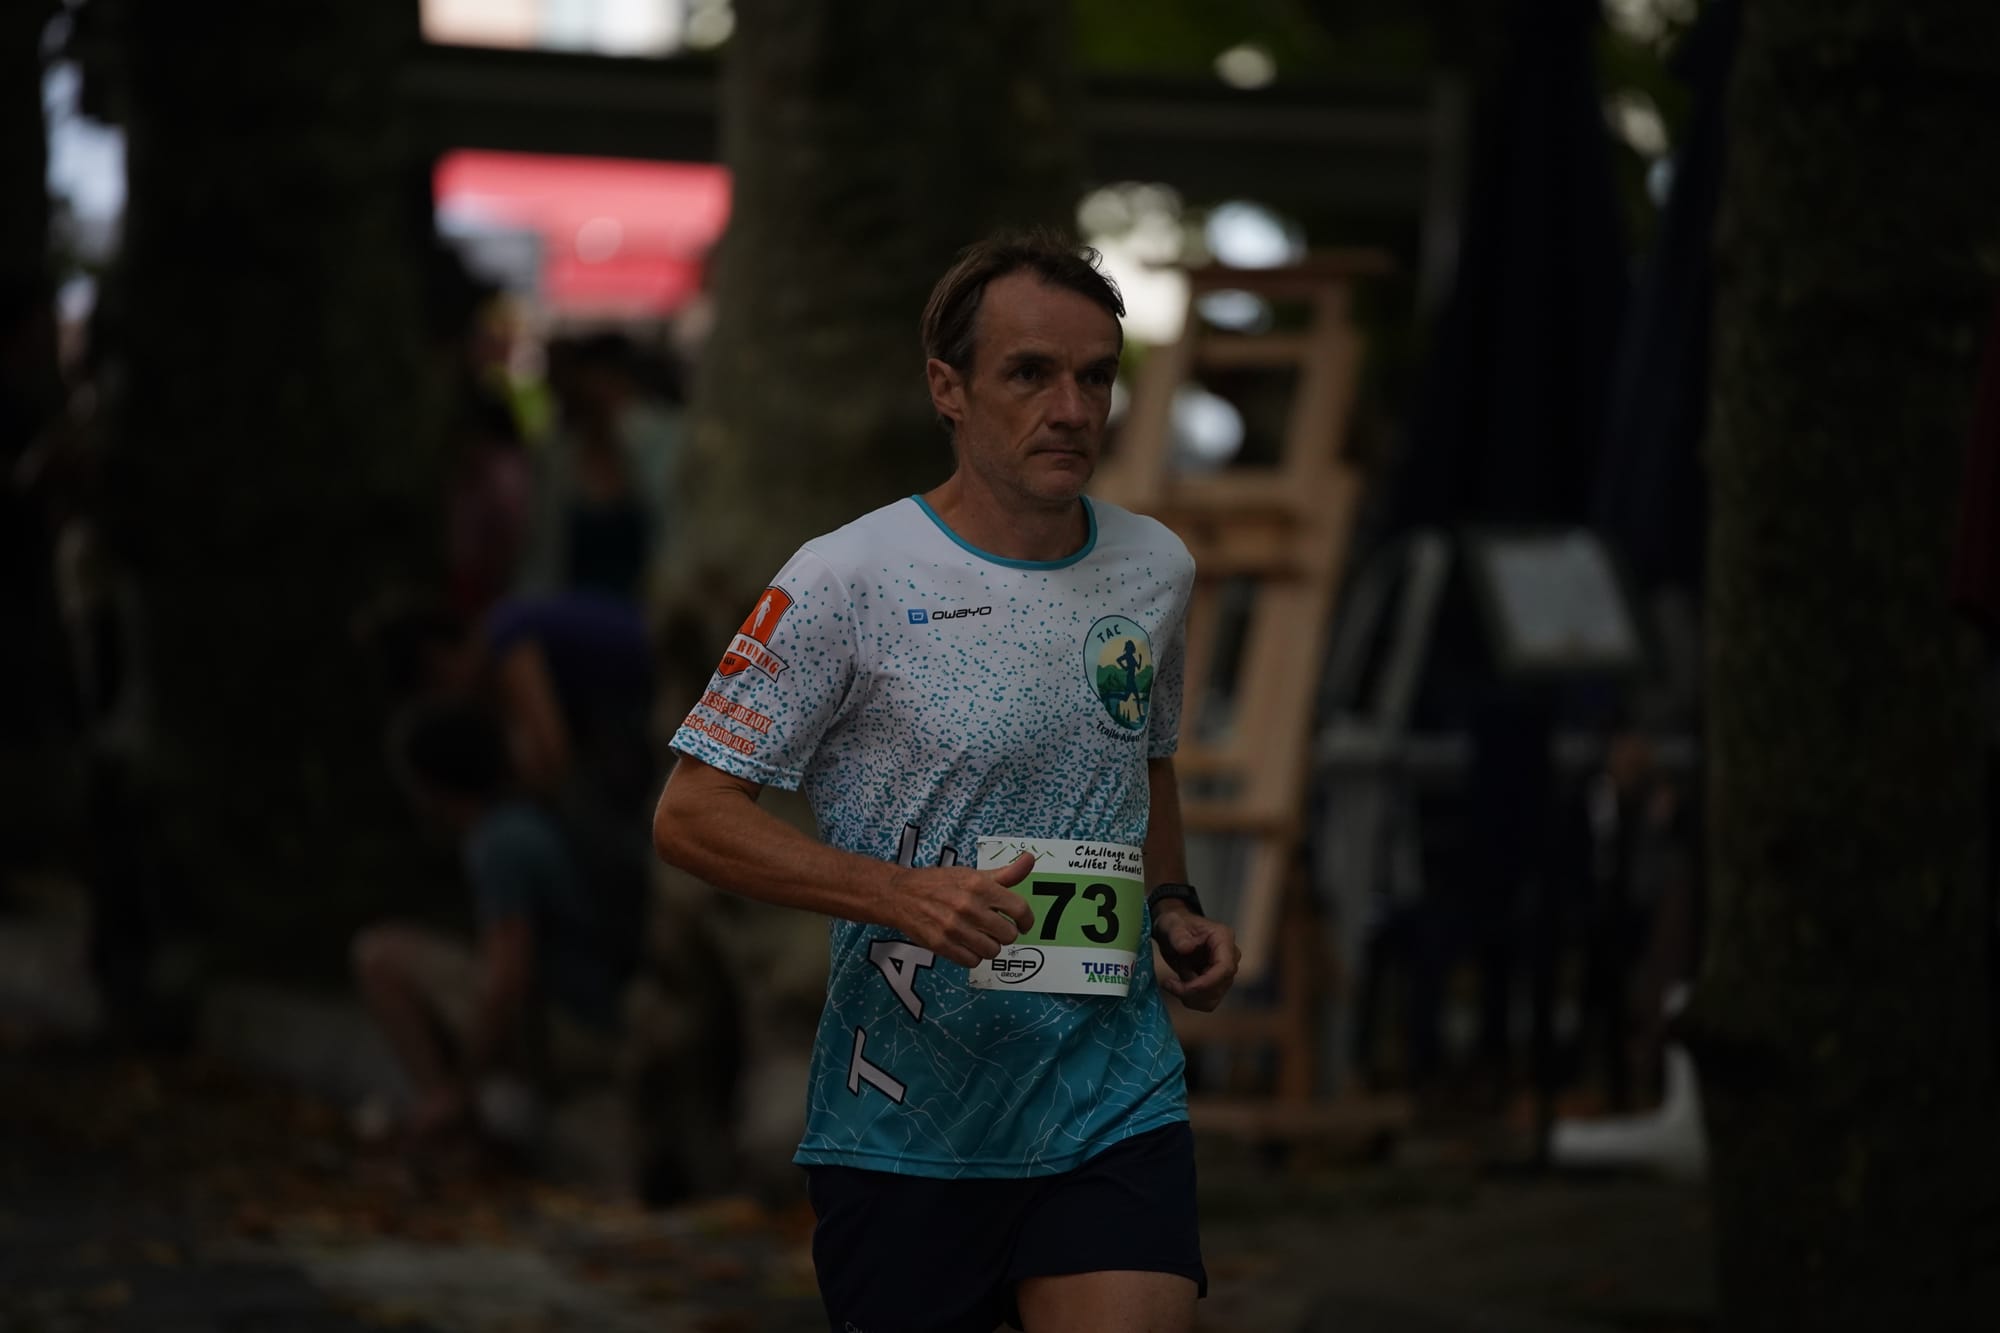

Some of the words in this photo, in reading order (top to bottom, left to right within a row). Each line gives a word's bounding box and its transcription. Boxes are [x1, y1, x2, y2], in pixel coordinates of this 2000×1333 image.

[1096, 624, 1122, 643] TAC
[1075, 845, 1125, 862] Challenge
[1129, 851, 1140, 862] des
[1068, 858, 1107, 870] vallées
[1032, 881, 1120, 944] 73
[991, 959, 1037, 972] BFP
[1082, 962, 1129, 977] TUFF'S
